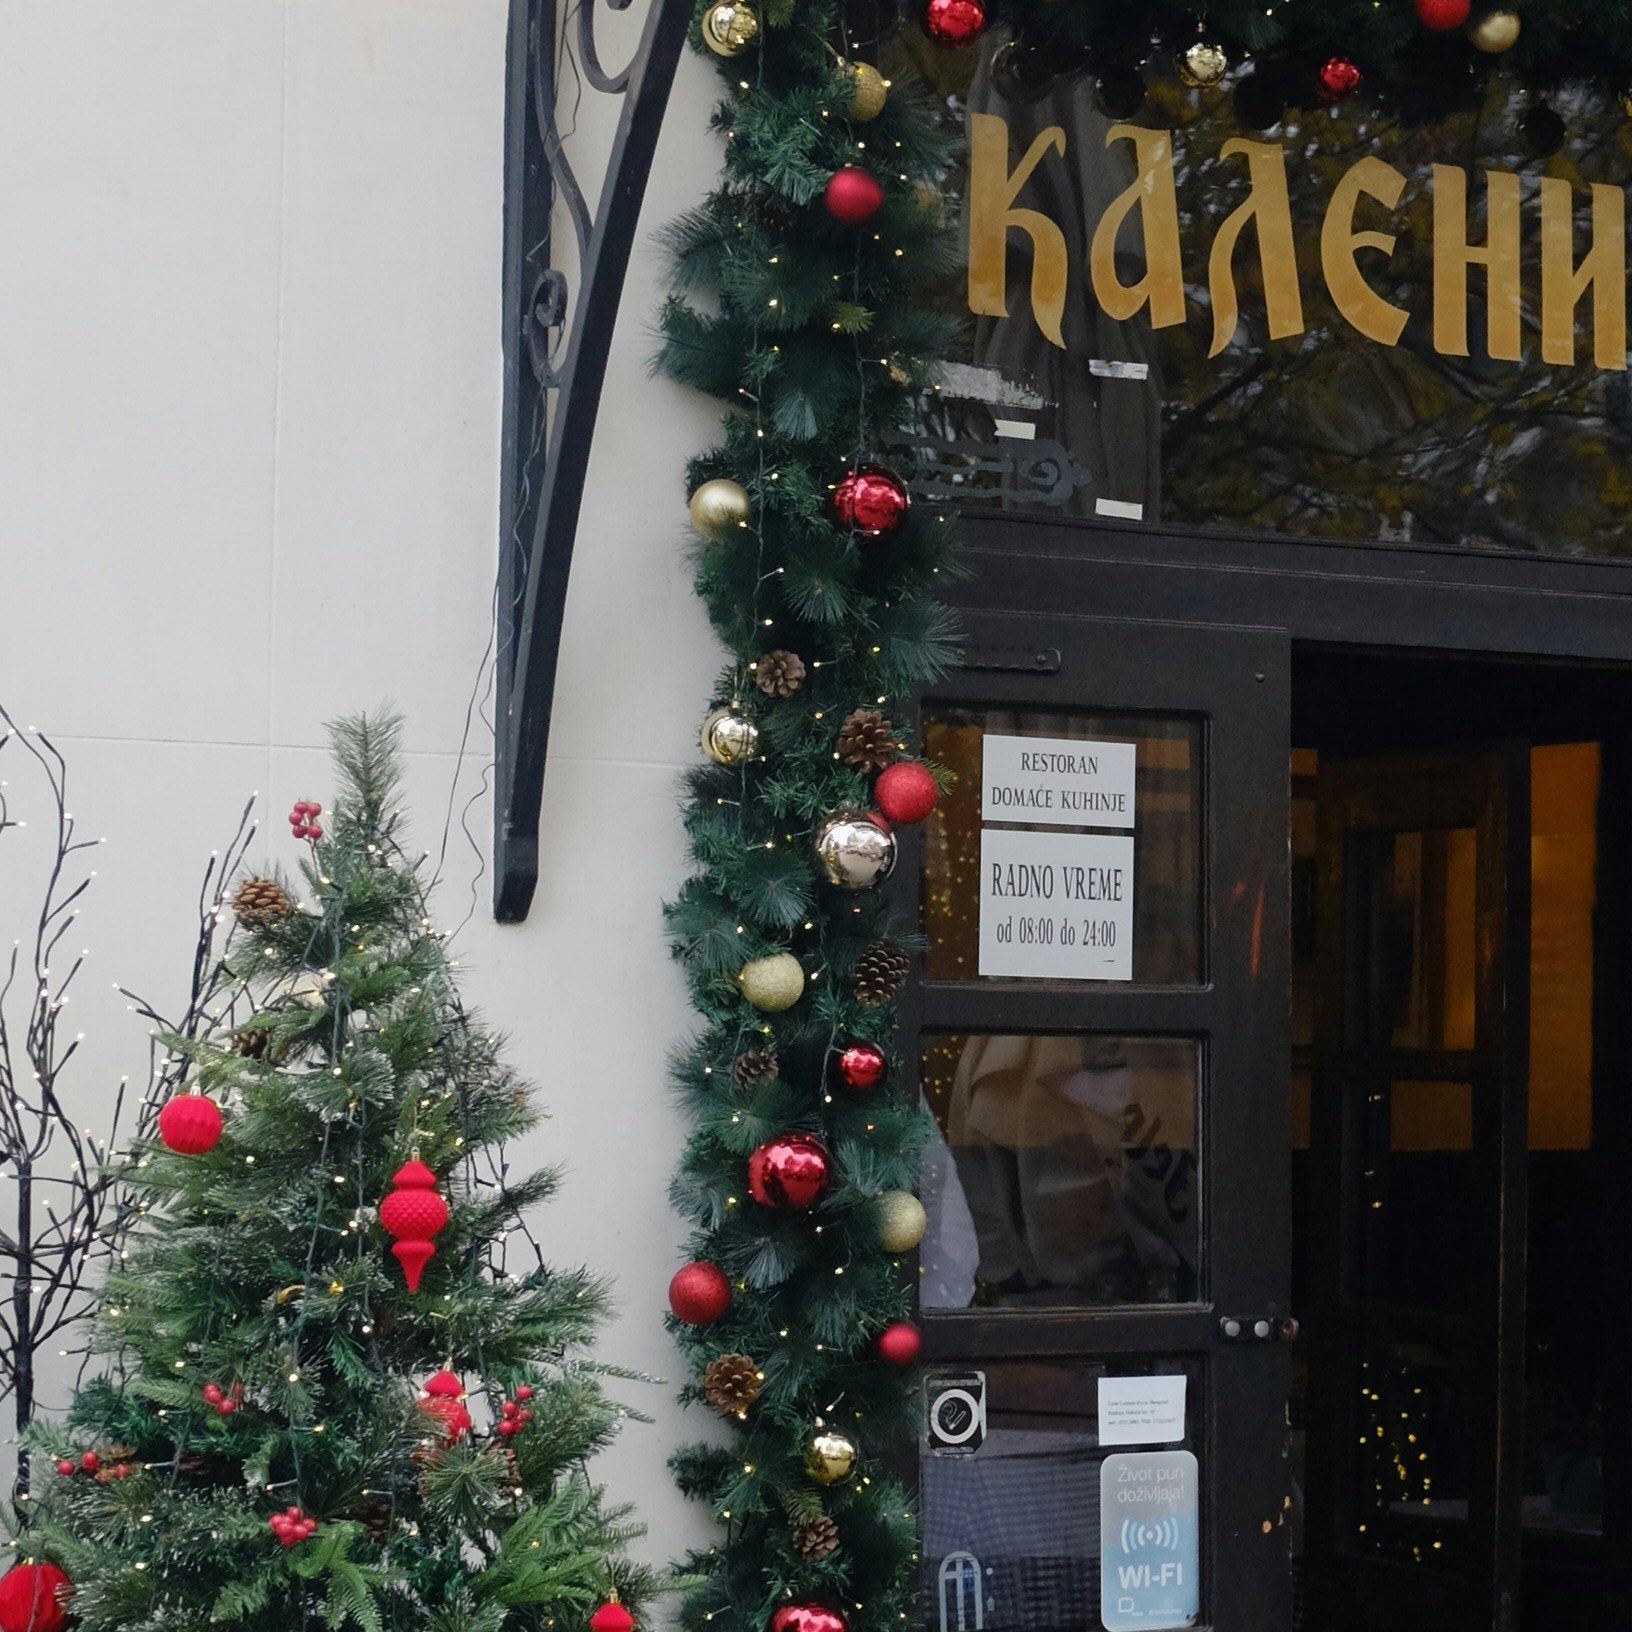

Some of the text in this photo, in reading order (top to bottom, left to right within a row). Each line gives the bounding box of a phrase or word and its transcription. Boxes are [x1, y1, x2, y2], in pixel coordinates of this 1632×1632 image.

[1021, 752, 1098, 775] RESTORAN
[992, 784, 1126, 812] DOMAĆE KUHINJE
[992, 863, 1123, 901] RADNO VREME
[997, 916, 1117, 947] od 08:00 do 24:00
[1118, 1465, 1184, 1485] Život pun
[1117, 1483, 1184, 1503] doživljaja!
[1118, 1563, 1182, 1589] WI-FI
